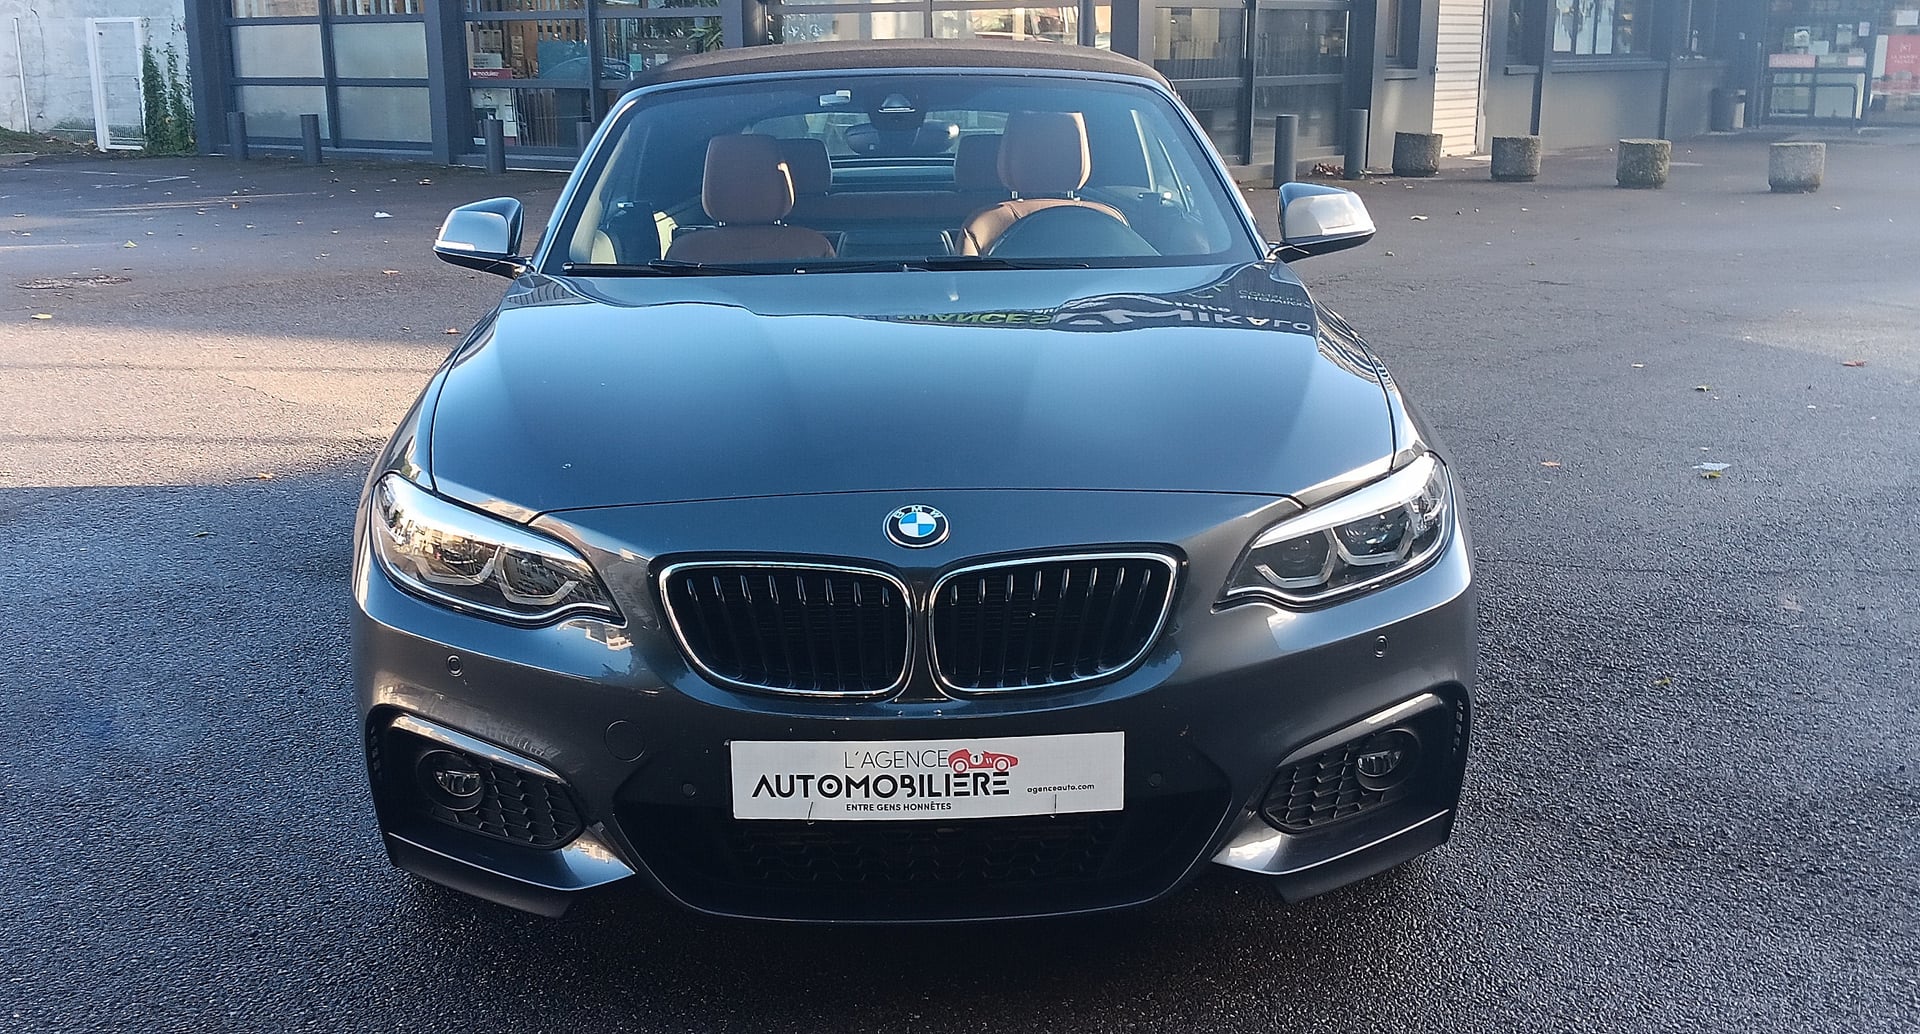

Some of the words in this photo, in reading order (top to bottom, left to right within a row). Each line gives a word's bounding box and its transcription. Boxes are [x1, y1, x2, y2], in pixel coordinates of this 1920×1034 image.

[844, 749, 949, 769] L'AGENCE
[1026, 782, 1095, 795] agenceauto.com
[846, 803, 874, 812] ENTRE
[876, 803, 901, 812] GENS
[903, 801, 952, 812] HONNÊTES
